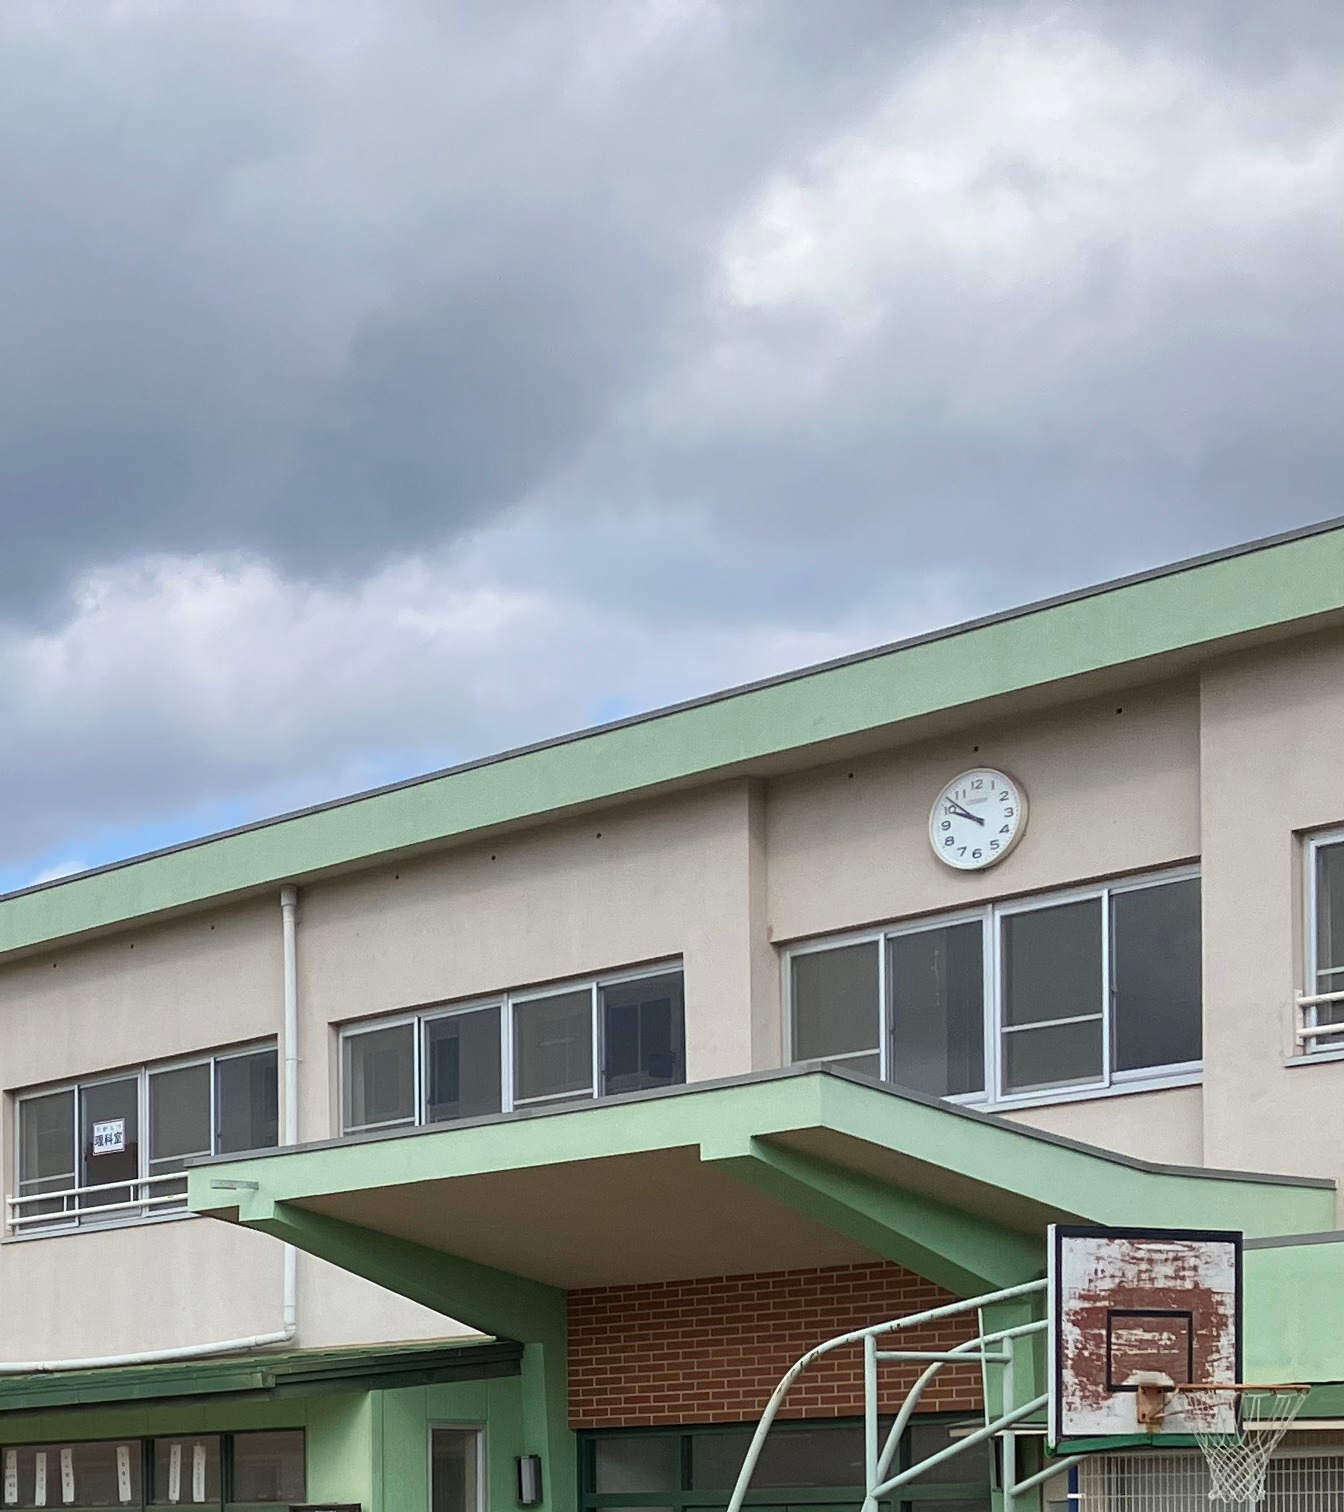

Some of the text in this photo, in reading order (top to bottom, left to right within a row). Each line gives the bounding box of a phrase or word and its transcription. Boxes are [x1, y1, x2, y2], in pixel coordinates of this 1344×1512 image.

[971, 779, 983, 790] 12
[991, 780, 995, 790] 1
[955, 789, 966, 800] 11
[999, 790, 1009, 801] 2
[1004, 807, 1014, 818] 3
[941, 820, 951, 831] 9
[999, 824, 1010, 833] 4
[944, 836, 955, 846] 8
[990, 839, 1000, 850] 5
[957, 846, 967, 857] 7
[972, 848, 982, 859] 6
[94, 1131, 123, 1147] 理科室
